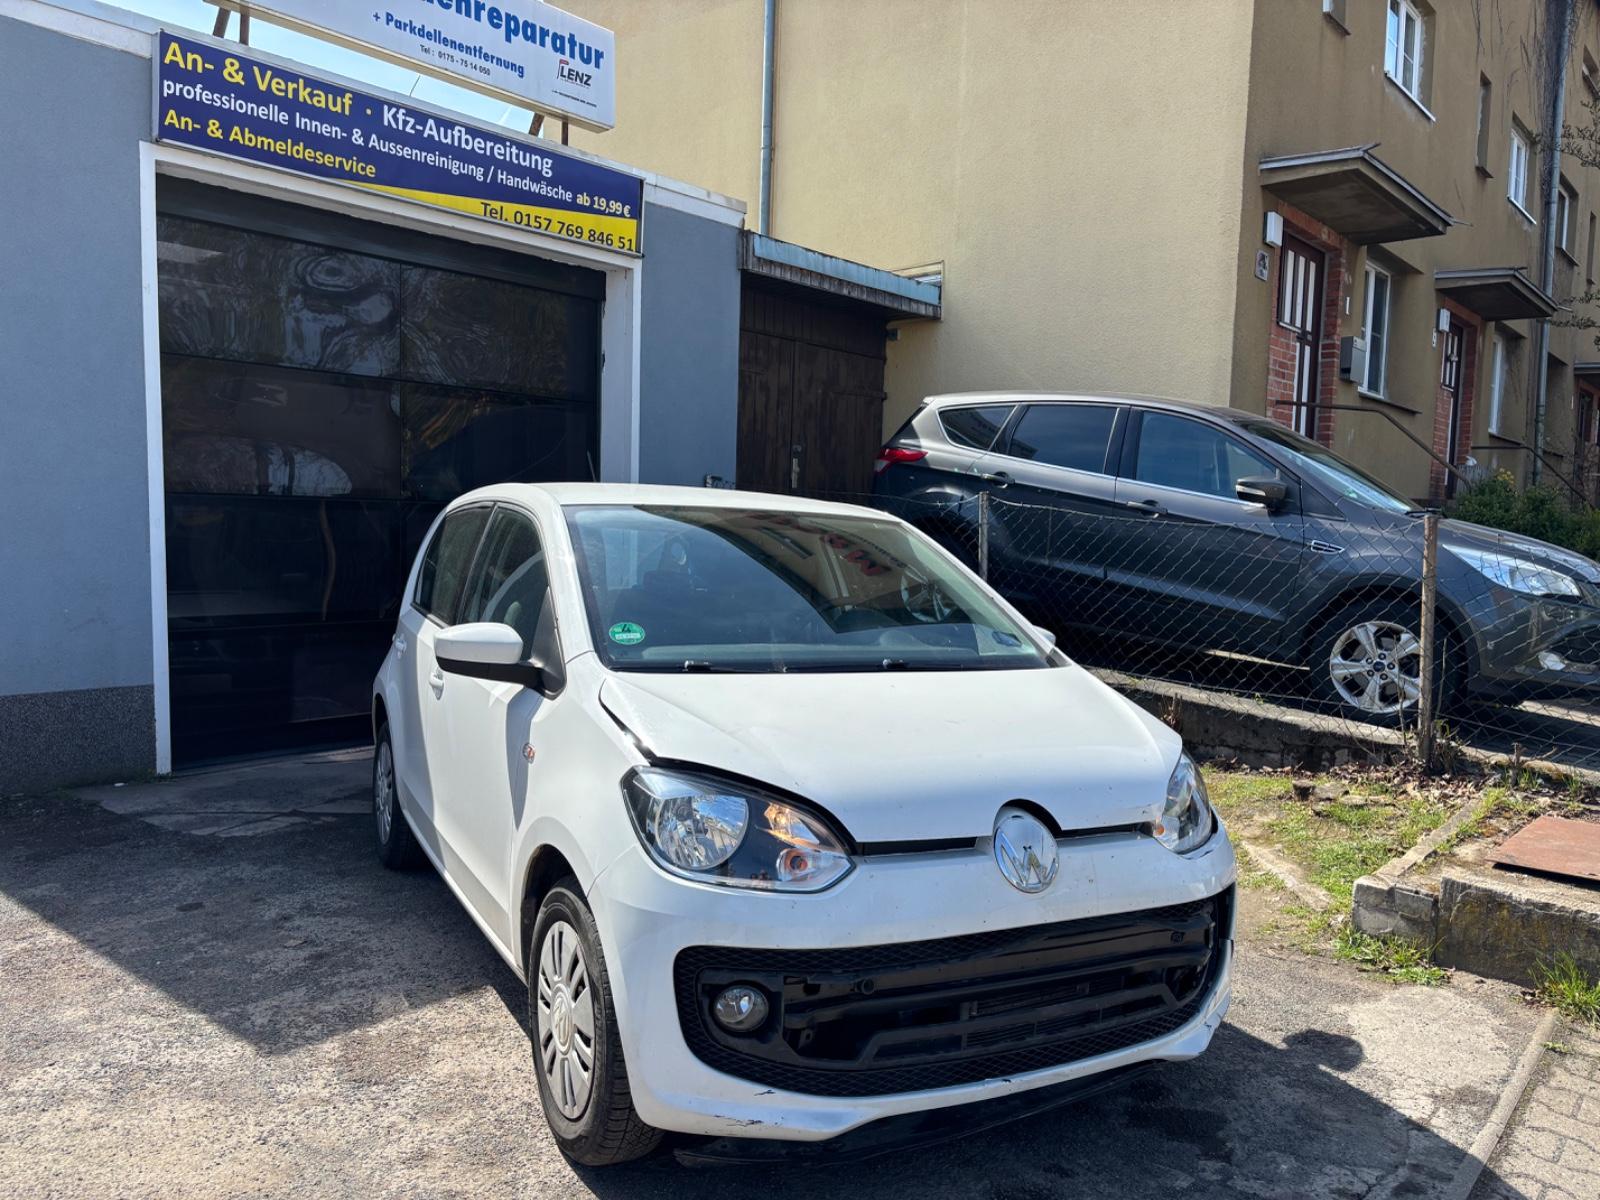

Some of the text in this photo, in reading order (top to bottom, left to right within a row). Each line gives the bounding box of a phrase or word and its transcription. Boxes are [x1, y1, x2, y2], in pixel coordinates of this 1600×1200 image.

[385, 11, 524, 78] Parkdellenentfernung
[437, 51, 455, 63] 0175
[460, 58, 469, 67] 75
[470, 62, 478, 71] 14
[560, 65, 592, 87] LENZ
[164, 41, 553, 177] An- & Verkauf Kfz-Aufbereitung
[163, 79, 289, 125] professionelle
[295, 111, 348, 140] Innen-
[351, 128, 364, 147] &
[368, 133, 484, 182] Aussenreinigung
[486, 166, 494, 184] /
[497, 169, 573, 202] Handwäsche
[576, 192, 591, 207] ab
[164, 109, 376, 178] An- & Abmeldeservice
[480, 201, 635, 252] Tel. 0157 769 846 51
